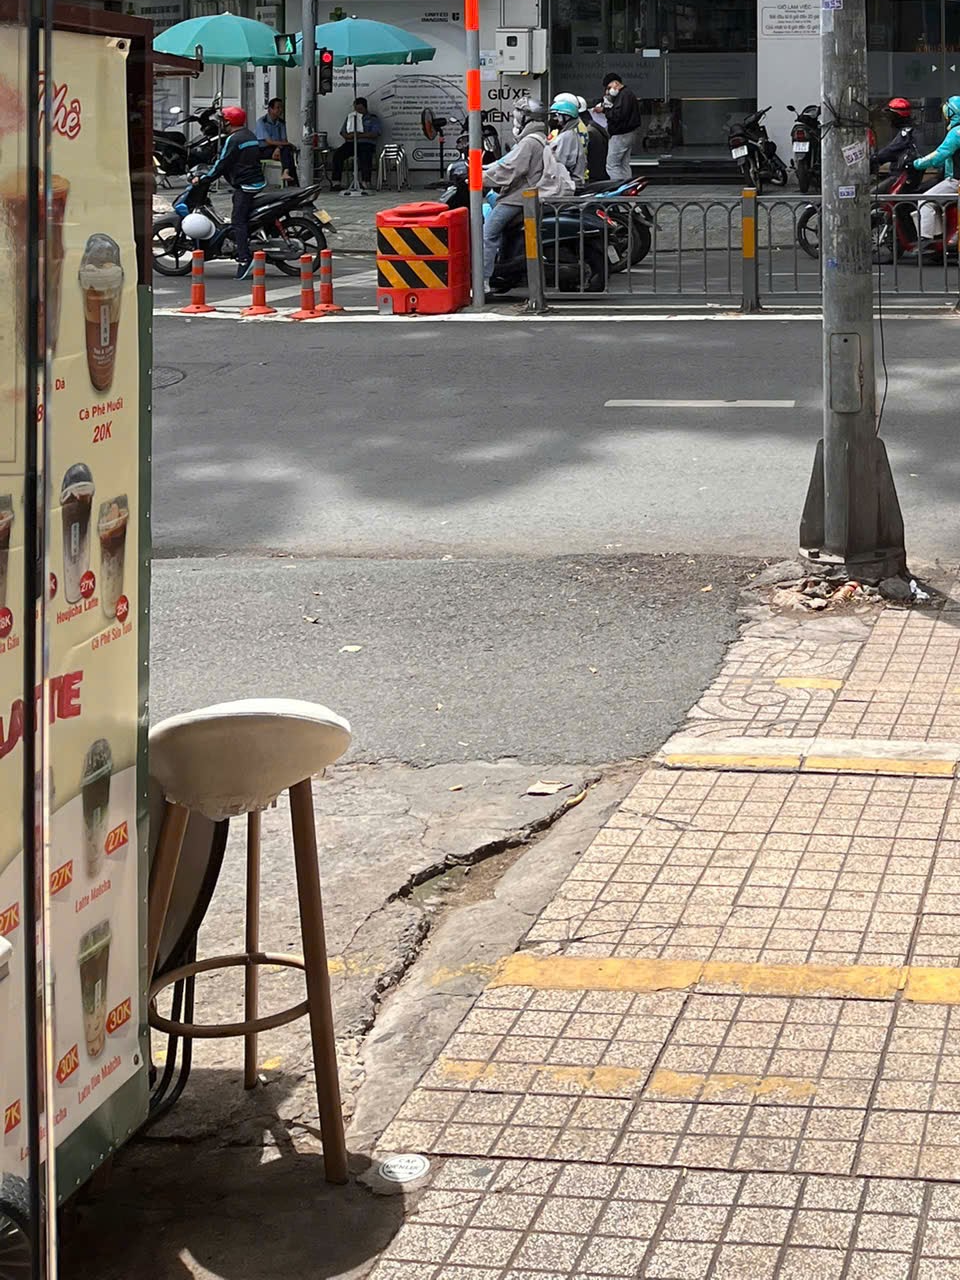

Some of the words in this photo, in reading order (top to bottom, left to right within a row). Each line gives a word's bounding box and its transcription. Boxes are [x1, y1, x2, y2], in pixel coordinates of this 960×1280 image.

[79, 408, 90, 421] Cà
[92, 420, 113, 444] 20K
[107, 823, 128, 852] 27K
[50, 862, 72, 893] 27K
[110, 999, 132, 1029] 30K
[60, 1047, 79, 1079] 30K
